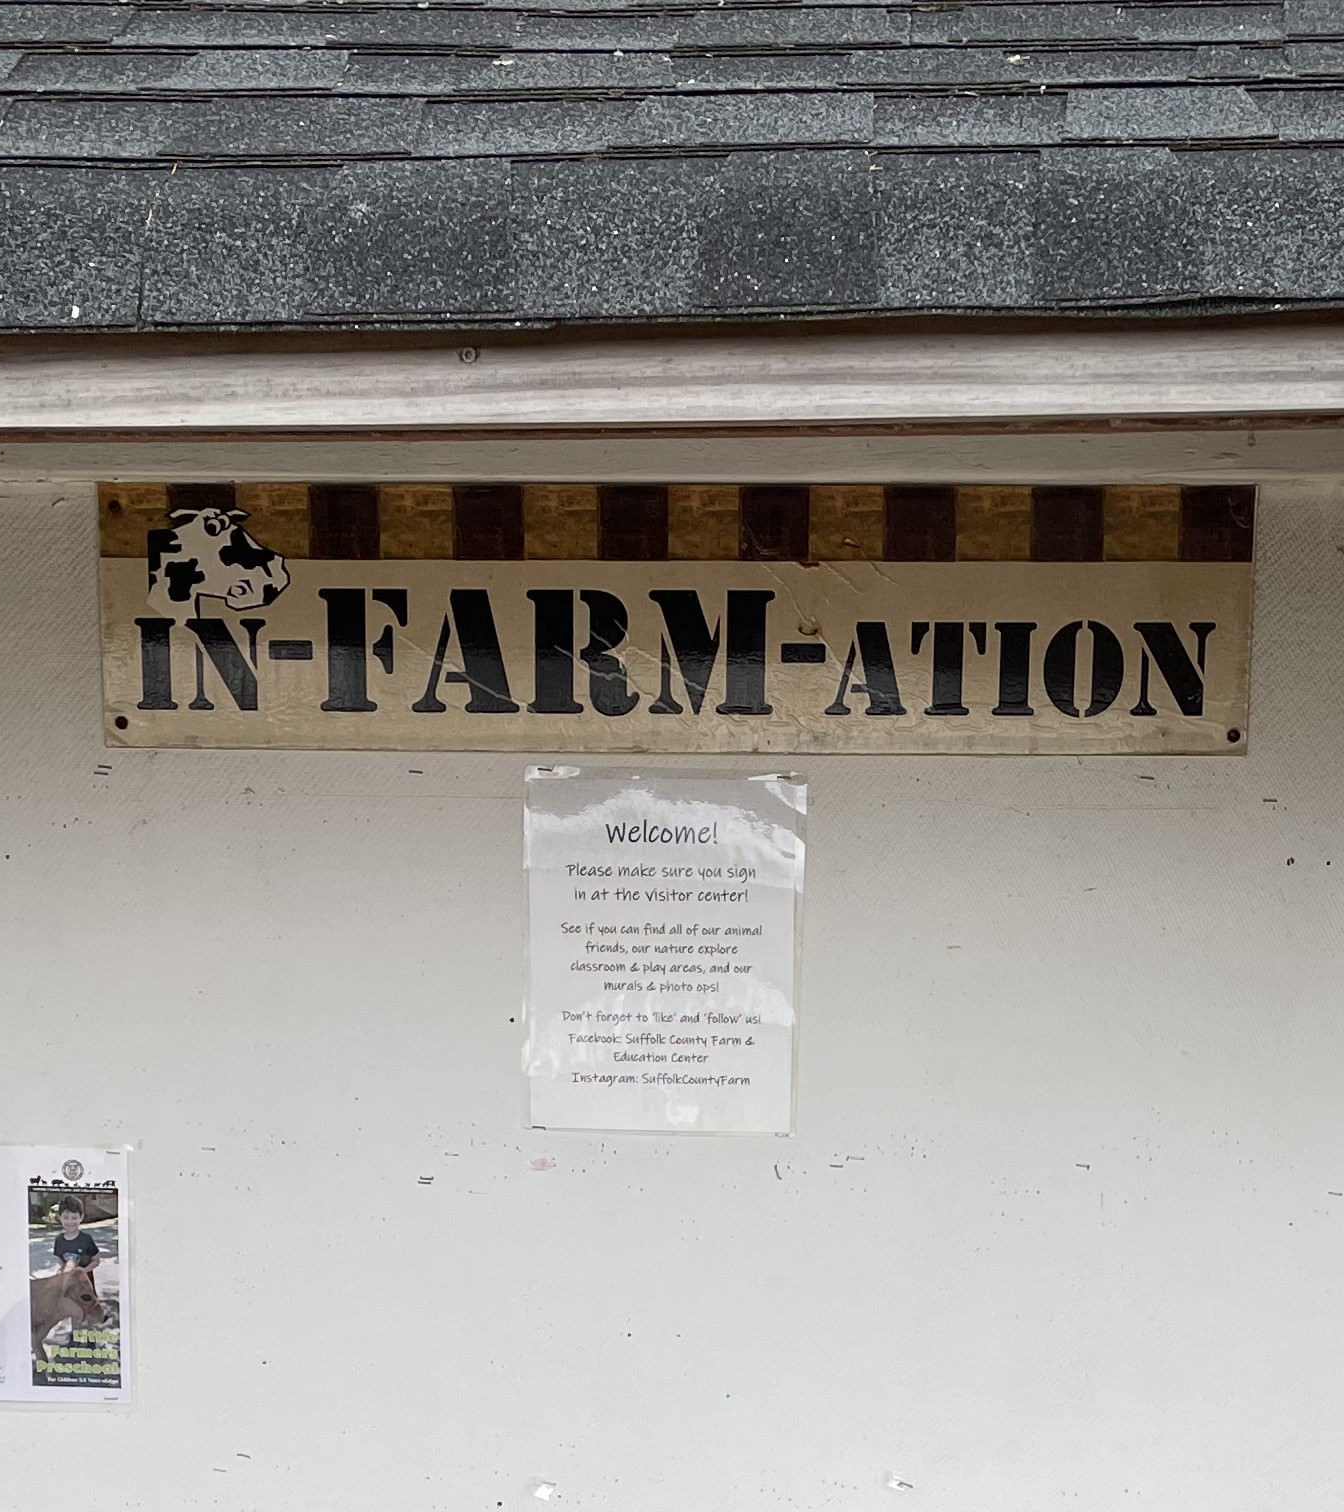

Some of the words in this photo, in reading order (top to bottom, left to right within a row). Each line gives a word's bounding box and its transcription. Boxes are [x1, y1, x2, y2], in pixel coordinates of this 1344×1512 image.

[606, 819, 718, 844] Welcome!
[566, 862, 612, 876] Please
[618, 864, 656, 876] make
[661, 866, 693, 877] sure
[698, 867, 721, 880] you
[727, 864, 756, 883] sign
[575, 887, 585, 900] in
[591, 889, 609, 900] at
[614, 888, 640, 901] the
[645, 888, 693, 901] visitor
[698, 889, 748, 902] center!
[561, 922, 581, 934] See
[586, 923, 595, 934] if
[598, 926, 616, 937] you
[621, 926, 639, 934] can
[644, 923, 665, 935] find
[669, 924, 682, 935] all
[686, 924, 698, 935] of
[702, 927, 720, 935] our
[725, 925, 762, 936] animal
[585, 941, 628, 955] friends,
[632, 945, 650, 953] our
[655, 944, 694, 953] nature
[698, 944, 738, 955] explore
[571, 961, 625, 971] classroom
[630, 962, 639, 972] &
[643, 962, 665, 974] play
[670, 965, 706, 974] areas,
[710, 962, 729, 973] and
[734, 965, 752, 973] our
[604, 980, 643, 991] murals
[647, 982, 656, 991] &
[660, 981, 692, 993] photo
[562, 1011, 592, 1021] Don't
[596, 1012, 632, 1025] forget
[636, 1013, 648, 1022] to
[680, 1012, 699, 1023] and
[626, 1034, 665, 1045] Suffolk
[670, 1035, 706, 1047] County
[711, 1035, 741, 1045] Farm
[745, 1036, 754, 1045] &
[613, 1052, 666, 1062] Education
[671, 1052, 709, 1063] Center
[572, 1073, 638, 1087] Instagram:
[642, 1073, 750, 1087] SuffolkCountyFarm
